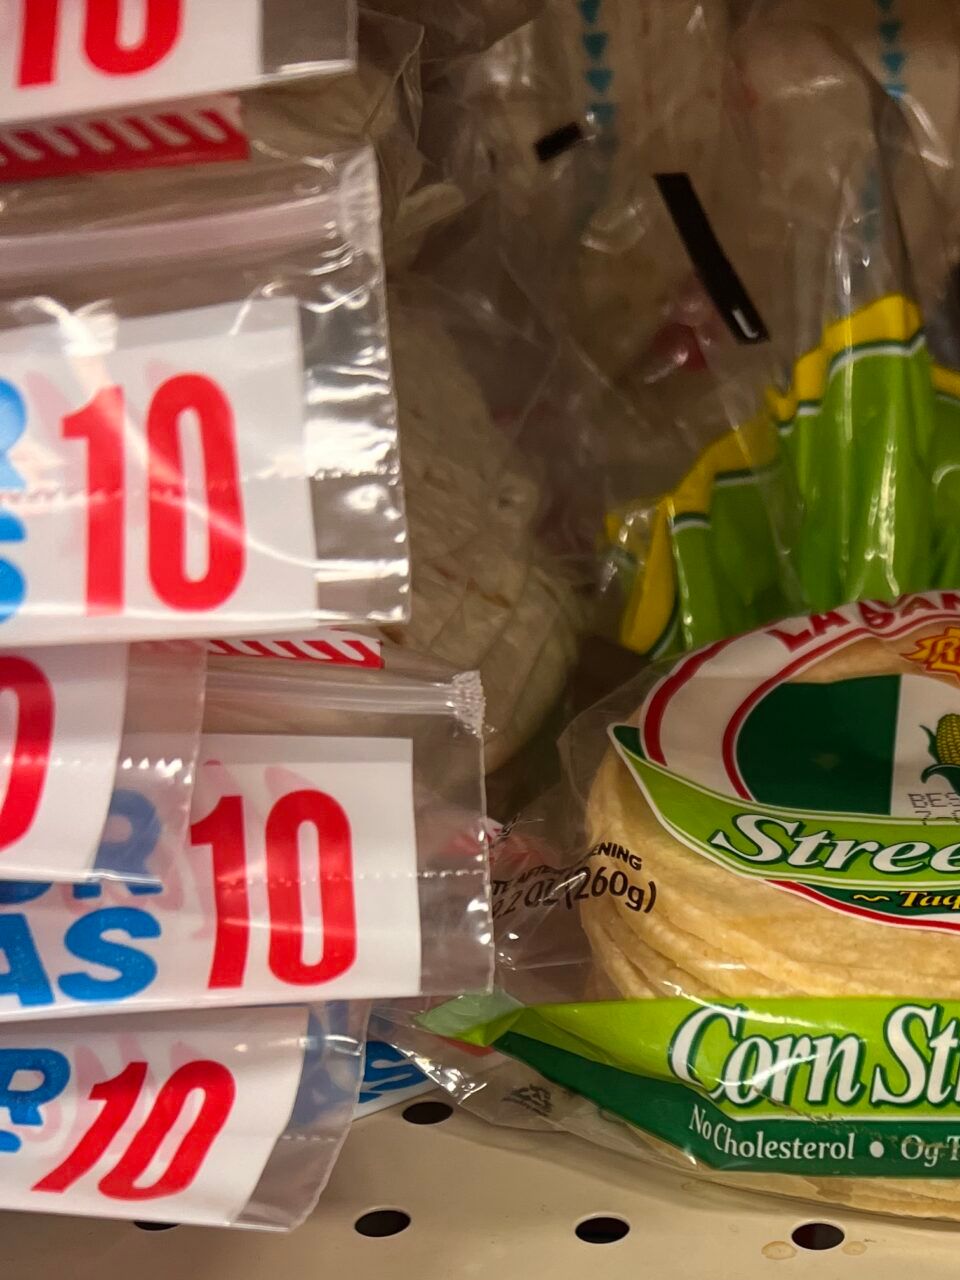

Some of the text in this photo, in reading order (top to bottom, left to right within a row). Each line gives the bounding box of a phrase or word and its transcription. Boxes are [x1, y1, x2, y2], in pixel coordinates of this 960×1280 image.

[62, 372, 246, 617] 10
[768, 611, 851, 653] LA
[189, 788, 357, 988] 10
[668, 1003, 866, 1107] Corn
[31, 1060, 236, 1200] 10
[689, 1104, 712, 1140] No
[713, 1122, 856, 1160] Cholesterol
